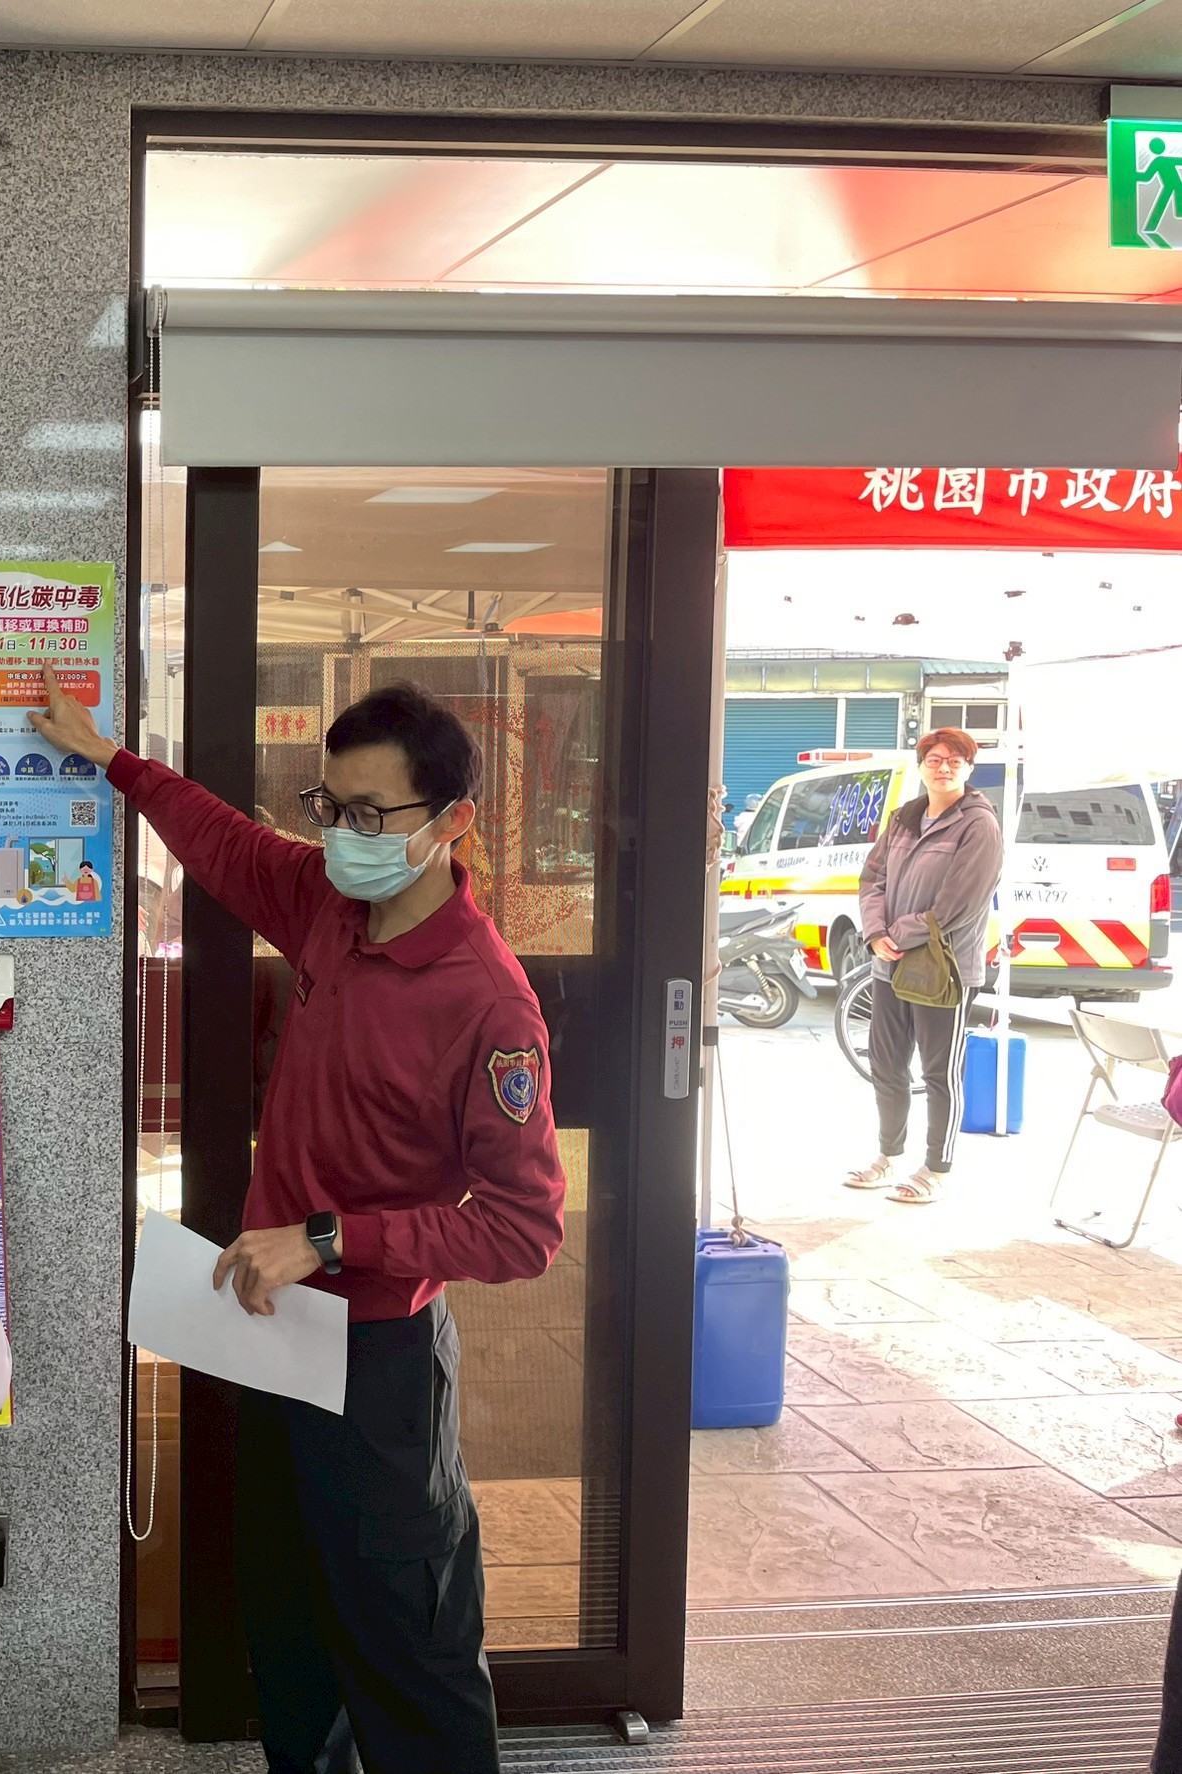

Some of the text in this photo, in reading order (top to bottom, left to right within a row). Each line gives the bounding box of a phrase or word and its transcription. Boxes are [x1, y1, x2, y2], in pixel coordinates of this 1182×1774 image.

[858, 467, 1182, 518] 桃園市政府
[826, 783, 861, 836] 119
[674, 990, 684, 1010] 自動
[671, 1035, 685, 1049] 押
